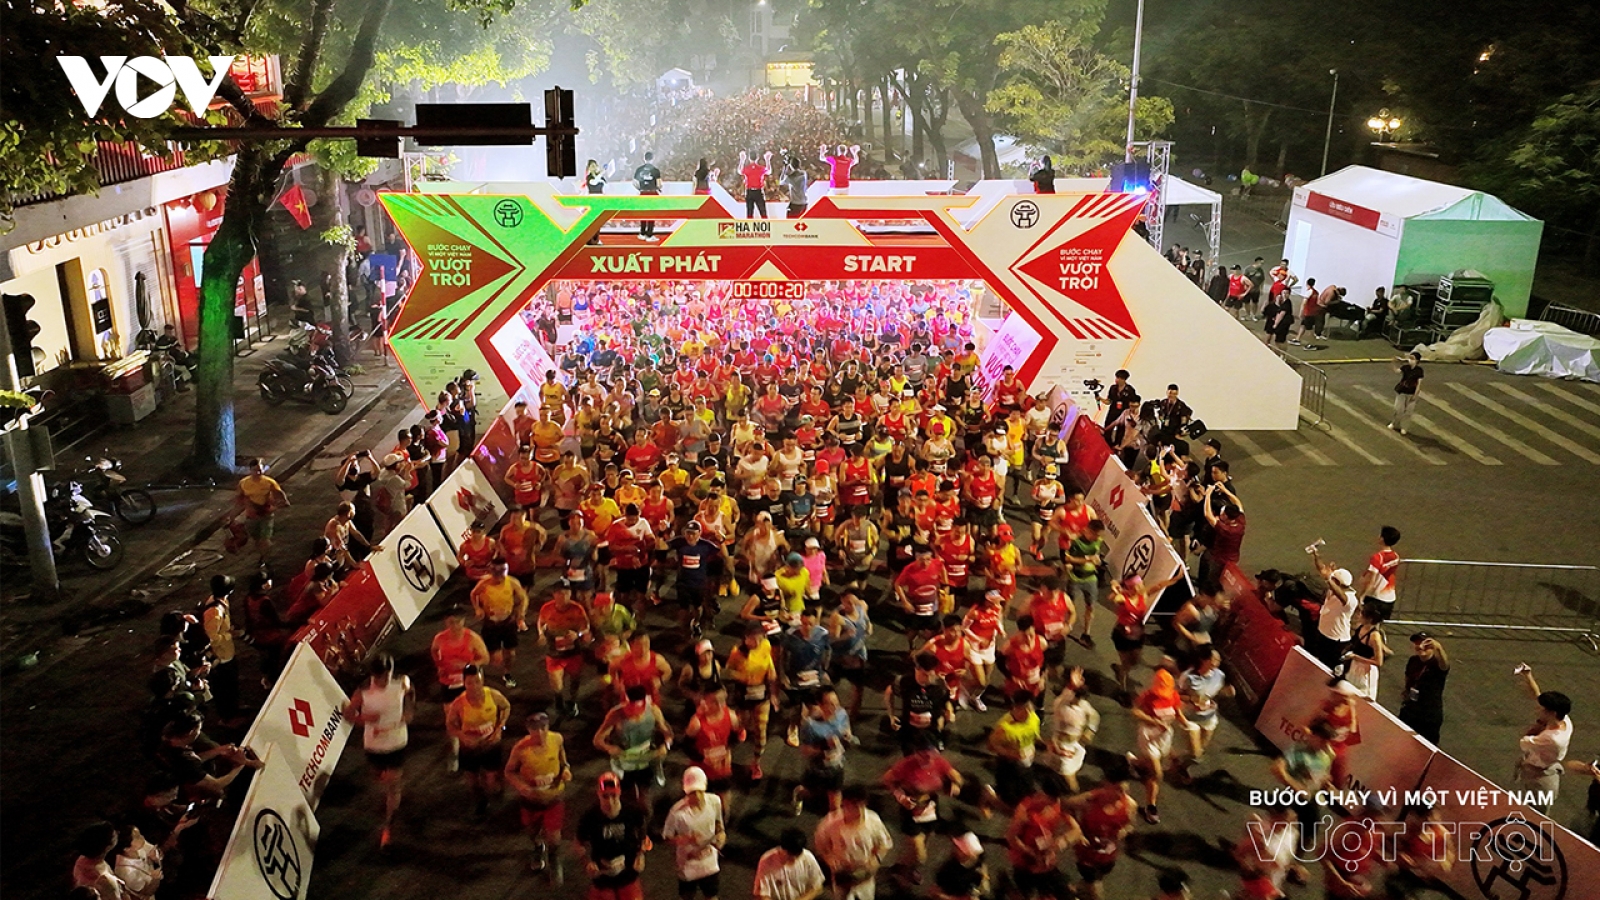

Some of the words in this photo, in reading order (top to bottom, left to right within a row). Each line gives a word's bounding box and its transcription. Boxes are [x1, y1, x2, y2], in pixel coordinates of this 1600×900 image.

[736, 222, 750, 232] HA
[753, 221, 771, 232] NOI
[428, 258, 473, 272] VƯỢT
[590, 252, 653, 273] XUẤT
[659, 251, 722, 272] PHÁT
[844, 255, 917, 272] START
[1059, 261, 1103, 276] VƯỢT
[429, 271, 471, 288] TRỘI
[1058, 275, 1099, 291] TRỘI
[734, 283, 803, 298] 00:00:20
[298, 705, 343, 793] TECHCOMBANK
